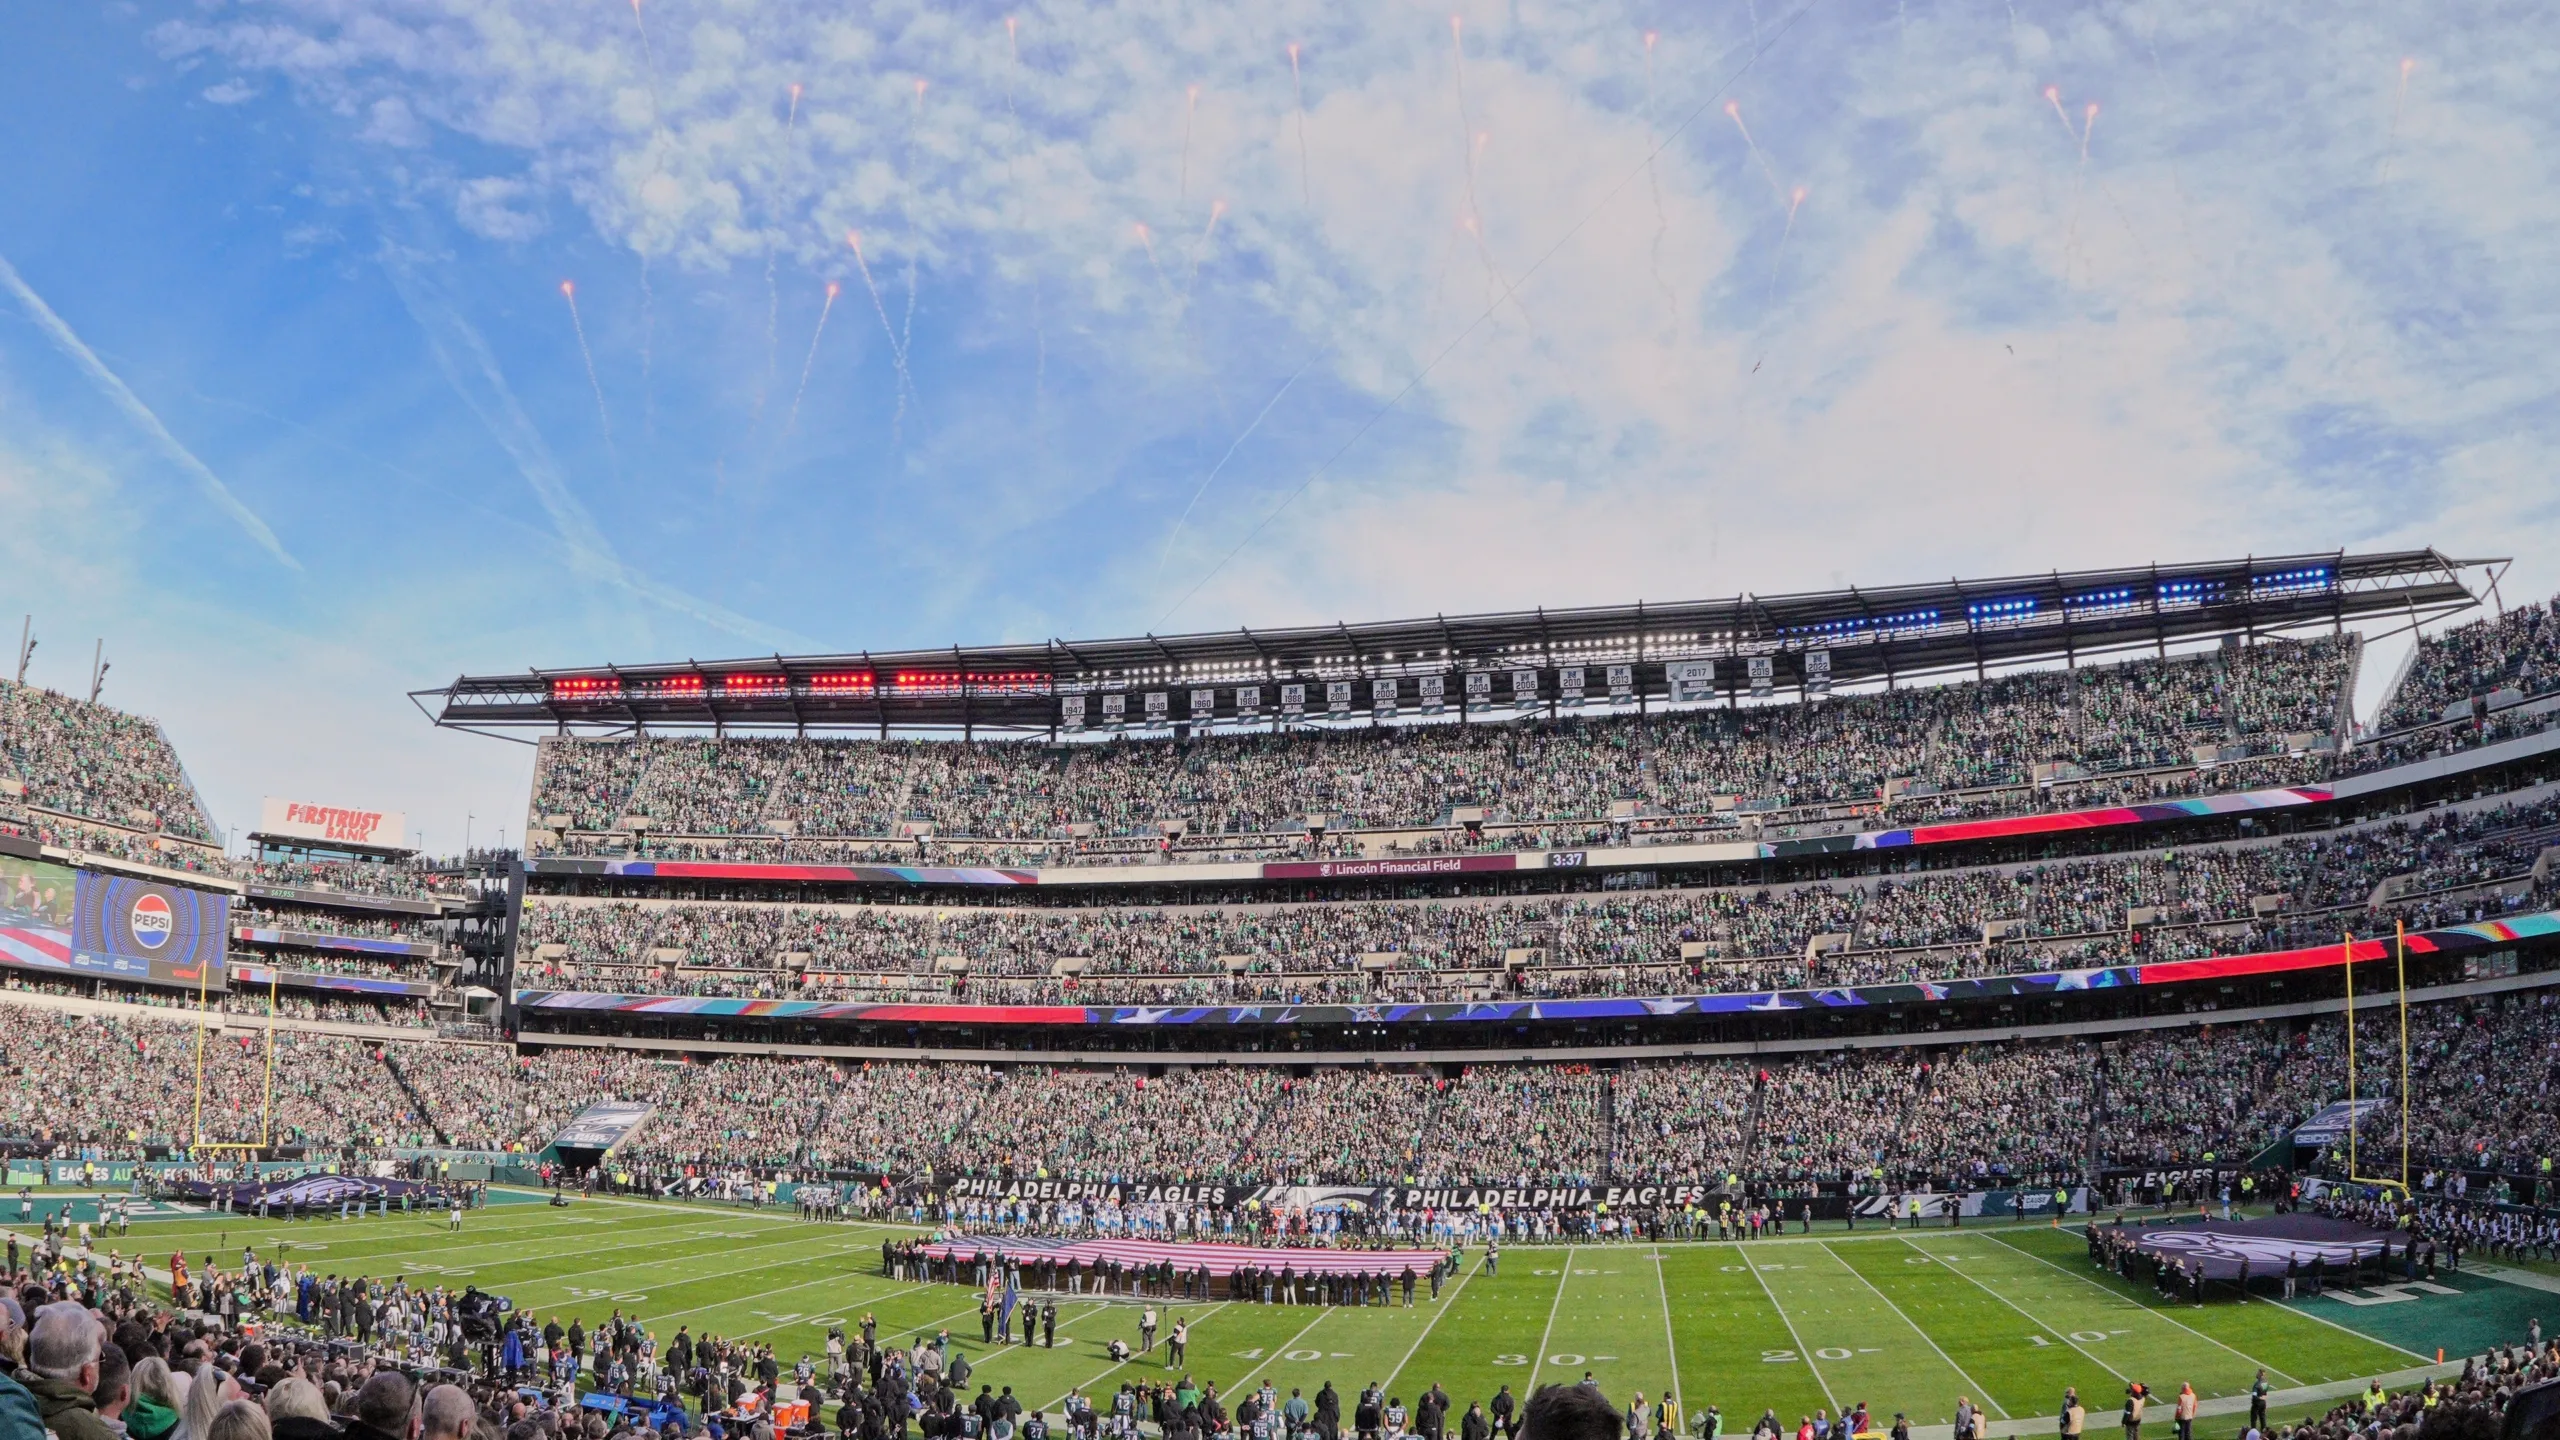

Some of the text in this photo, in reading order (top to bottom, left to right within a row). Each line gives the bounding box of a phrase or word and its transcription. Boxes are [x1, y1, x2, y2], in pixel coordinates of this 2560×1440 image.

[1686, 668, 1707, 676] 2017
[1752, 667, 1770, 675] 2019
[1808, 663, 1828, 671] 2022
[1516, 680, 1536, 689] 2006
[1563, 678, 1581, 686] 2010
[1611, 675, 1629, 684] 2013
[1422, 686, 1442, 695] 2003
[1468, 684, 1488, 692] 2004
[1284, 695, 1302, 703] 1988
[1375, 690, 1395, 698] 2002
[1148, 702, 1165, 710] 1949
[1240, 697, 1257, 705] 1980
[1065, 706, 1083, 714] 1947
[325, 827, 370, 842] BANK
[1553, 853, 1582, 866] 3:37
[1336, 858, 1461, 875] Lincoln Financial Field
[271, 889, 295, 898] $67,955
[134, 913, 170, 929] PEPSI
[2294, 1133, 2331, 1144] GEICO
[58, 1166, 109, 1181] EAGES
[957, 1178, 1226, 1204] PHILADELPHIA EAGLES
[1406, 1186, 1705, 1208] PHILADELPHIA EAGLES
[1229, 1347, 1322, 1361] 40
[1761, 1347, 1853, 1363] 20
[1491, 1353, 1586, 1367] 30
[798, 1366, 809, 1377] 26
[1388, 1412, 1403, 1423] 59
[965, 1420, 972, 1432] 8
[1030, 1427, 1043, 1438] 27
[1253, 1426, 1268, 1438] 95
